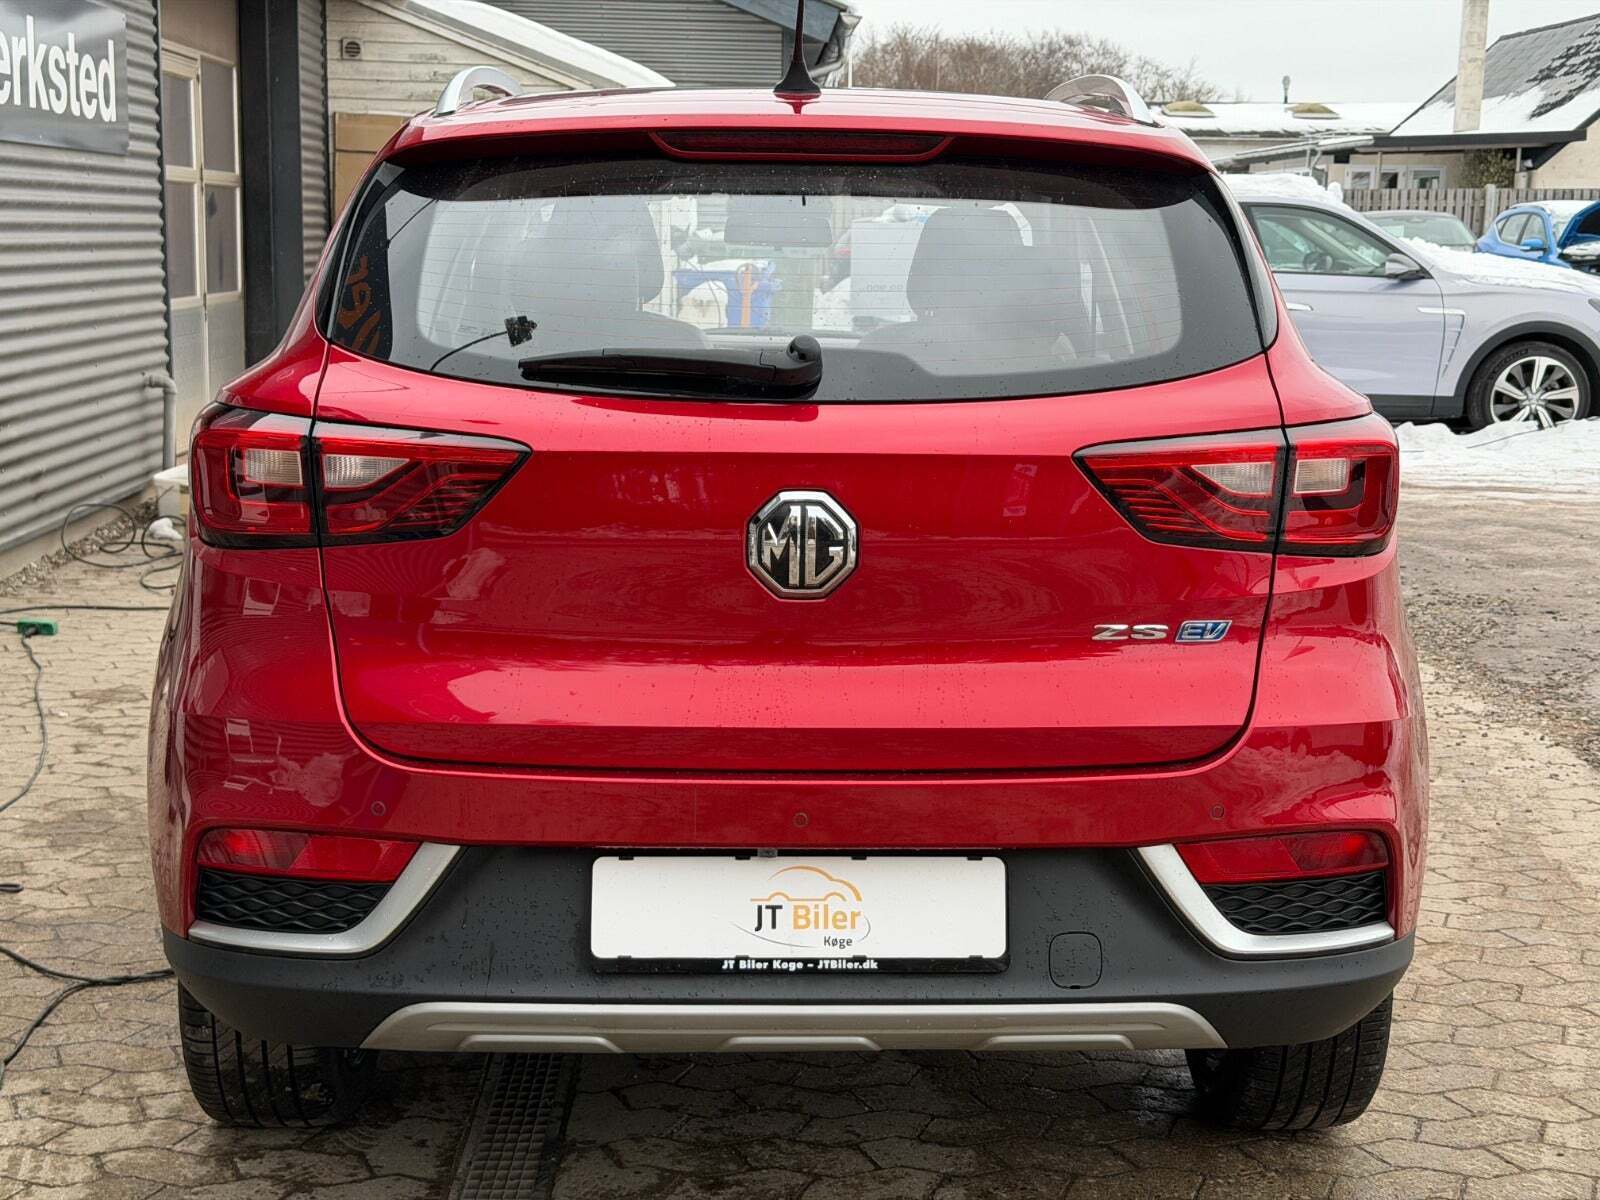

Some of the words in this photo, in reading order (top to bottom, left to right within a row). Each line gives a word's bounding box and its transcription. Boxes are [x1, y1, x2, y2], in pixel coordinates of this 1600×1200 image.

[760, 504, 845, 588] MG
[1091, 623, 1169, 641] ZS
[1180, 621, 1228, 640] EV
[754, 904, 783, 932] JT
[792, 903, 861, 930] Biler
[823, 935, 853, 950] Køge
[721, 959, 736, 969] JT
[738, 959, 769, 970] Biler
[817, 959, 879, 970] JTBiler.dk
